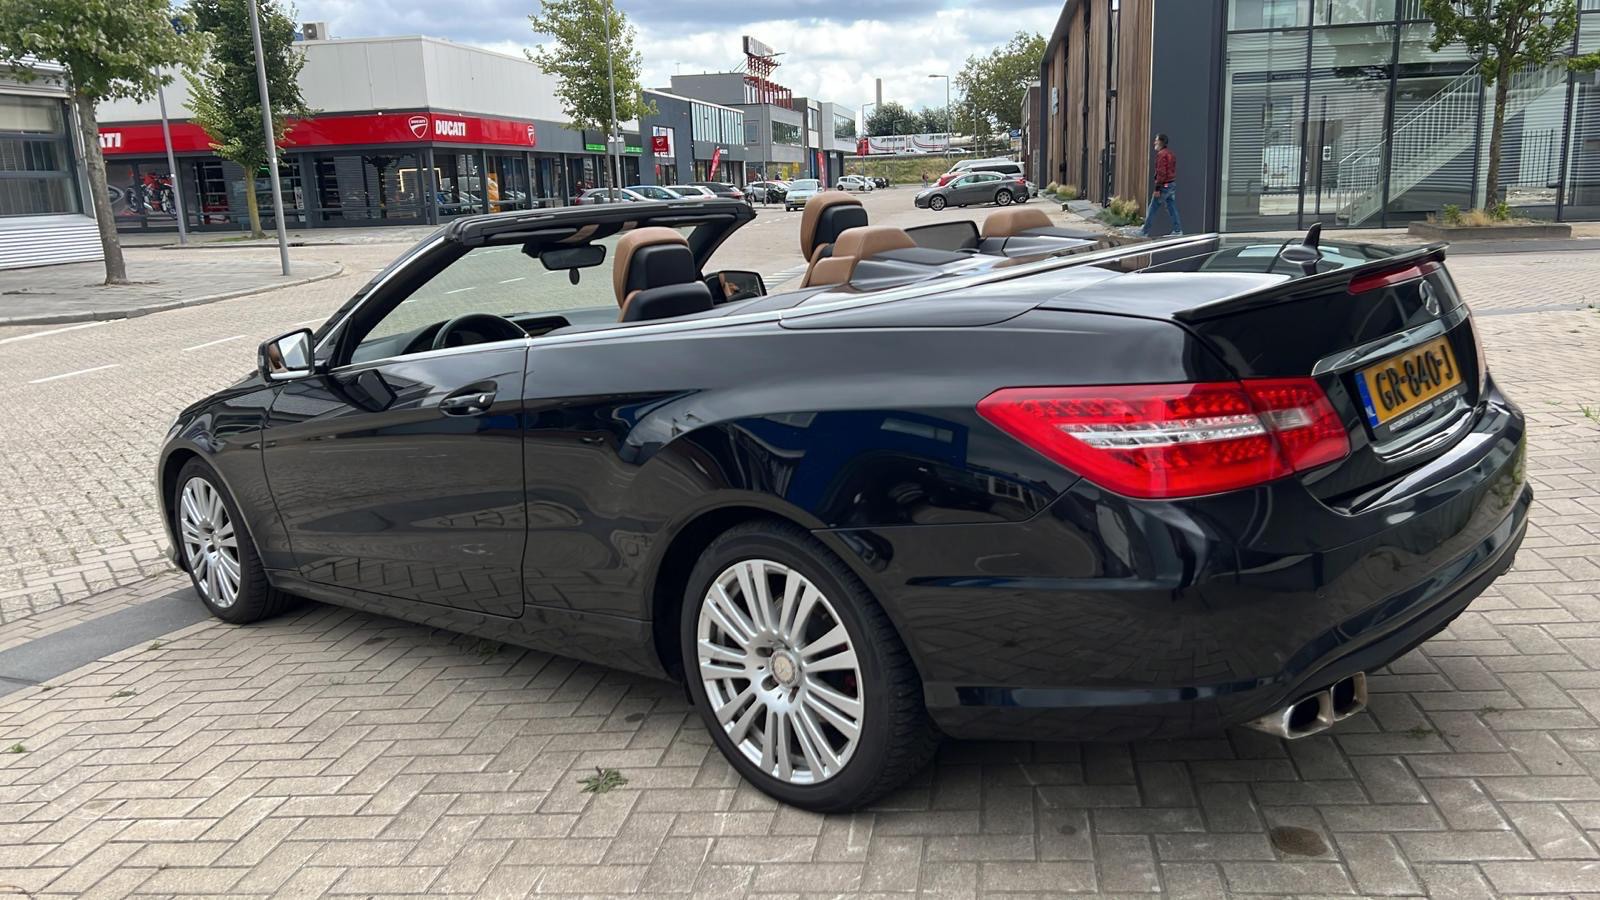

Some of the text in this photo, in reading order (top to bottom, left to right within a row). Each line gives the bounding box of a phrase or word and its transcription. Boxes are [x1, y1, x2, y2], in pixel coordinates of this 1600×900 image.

[435, 120, 466, 137] DUCATI
[98, 133, 121, 148] ATI
[1376, 345, 1454, 411] GR-840-J
